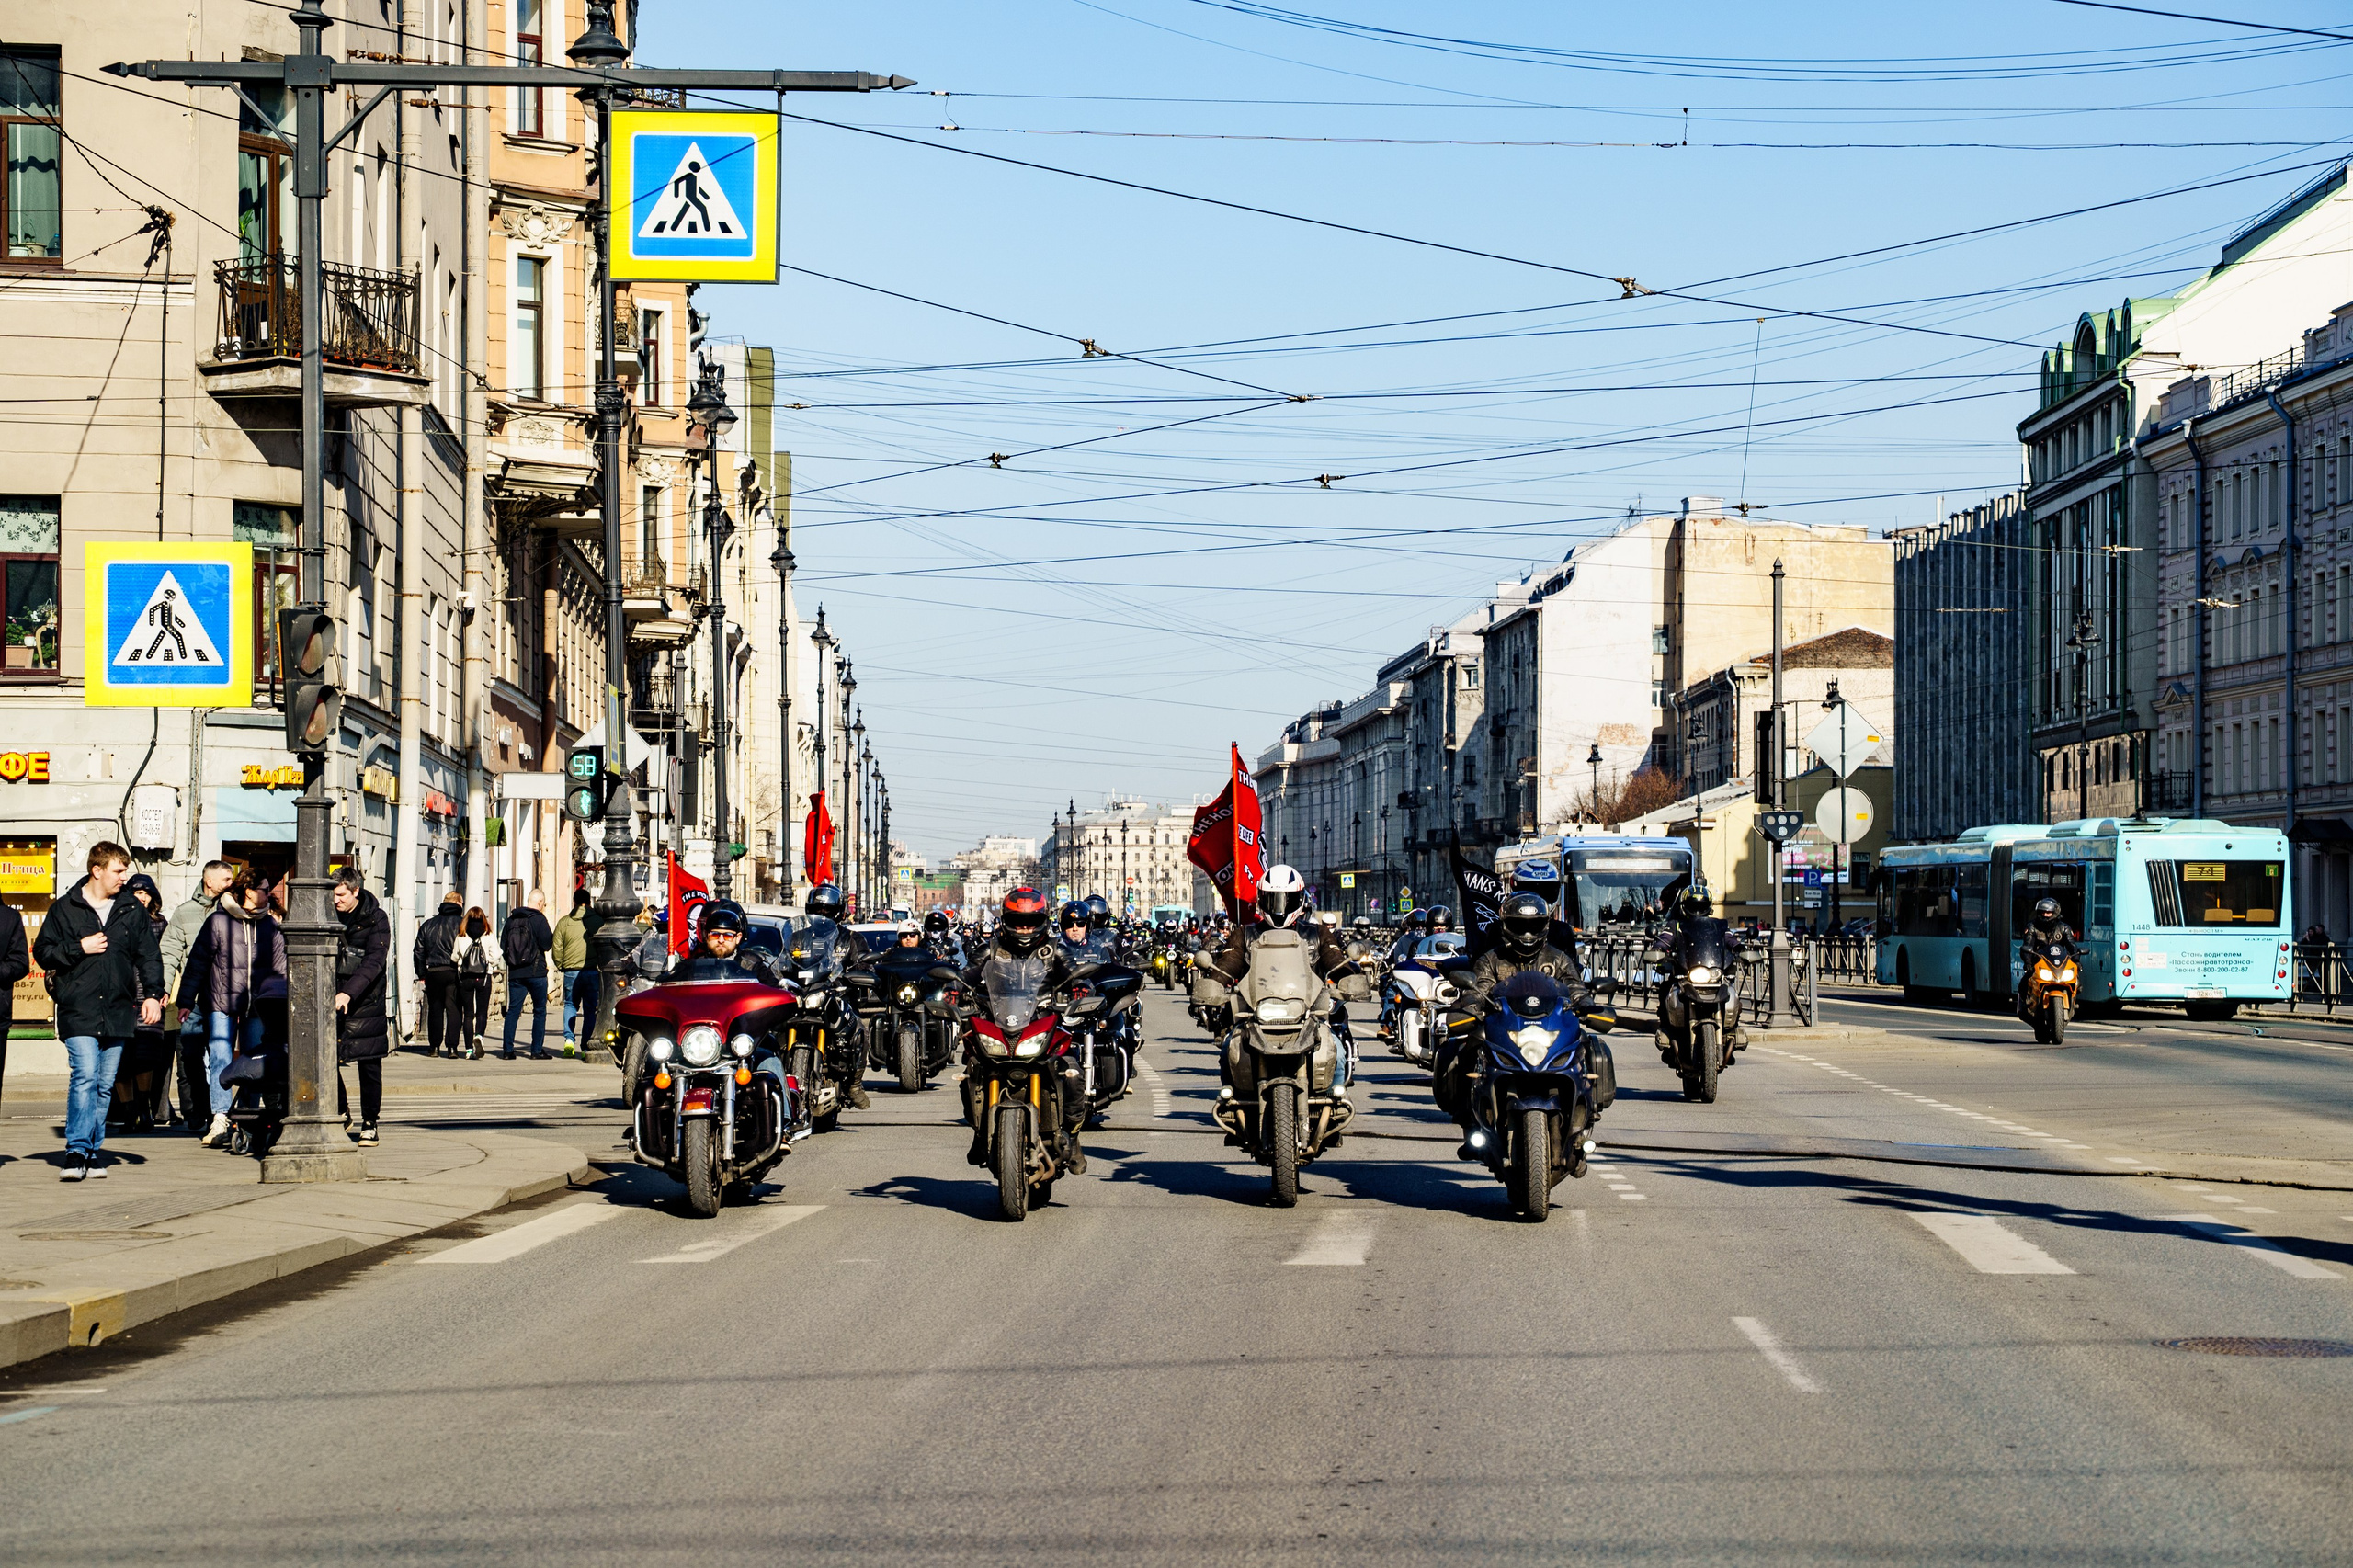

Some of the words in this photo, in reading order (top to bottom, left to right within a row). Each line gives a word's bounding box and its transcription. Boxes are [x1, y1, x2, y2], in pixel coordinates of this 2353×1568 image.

[0, 751, 50, 781] ФЕ
[245, 765, 279, 789] Жар
[573, 755, 597, 777] 58
[141, 809, 162, 821] ХОСТЕЛ
[2, 862, 45, 877] Птица
